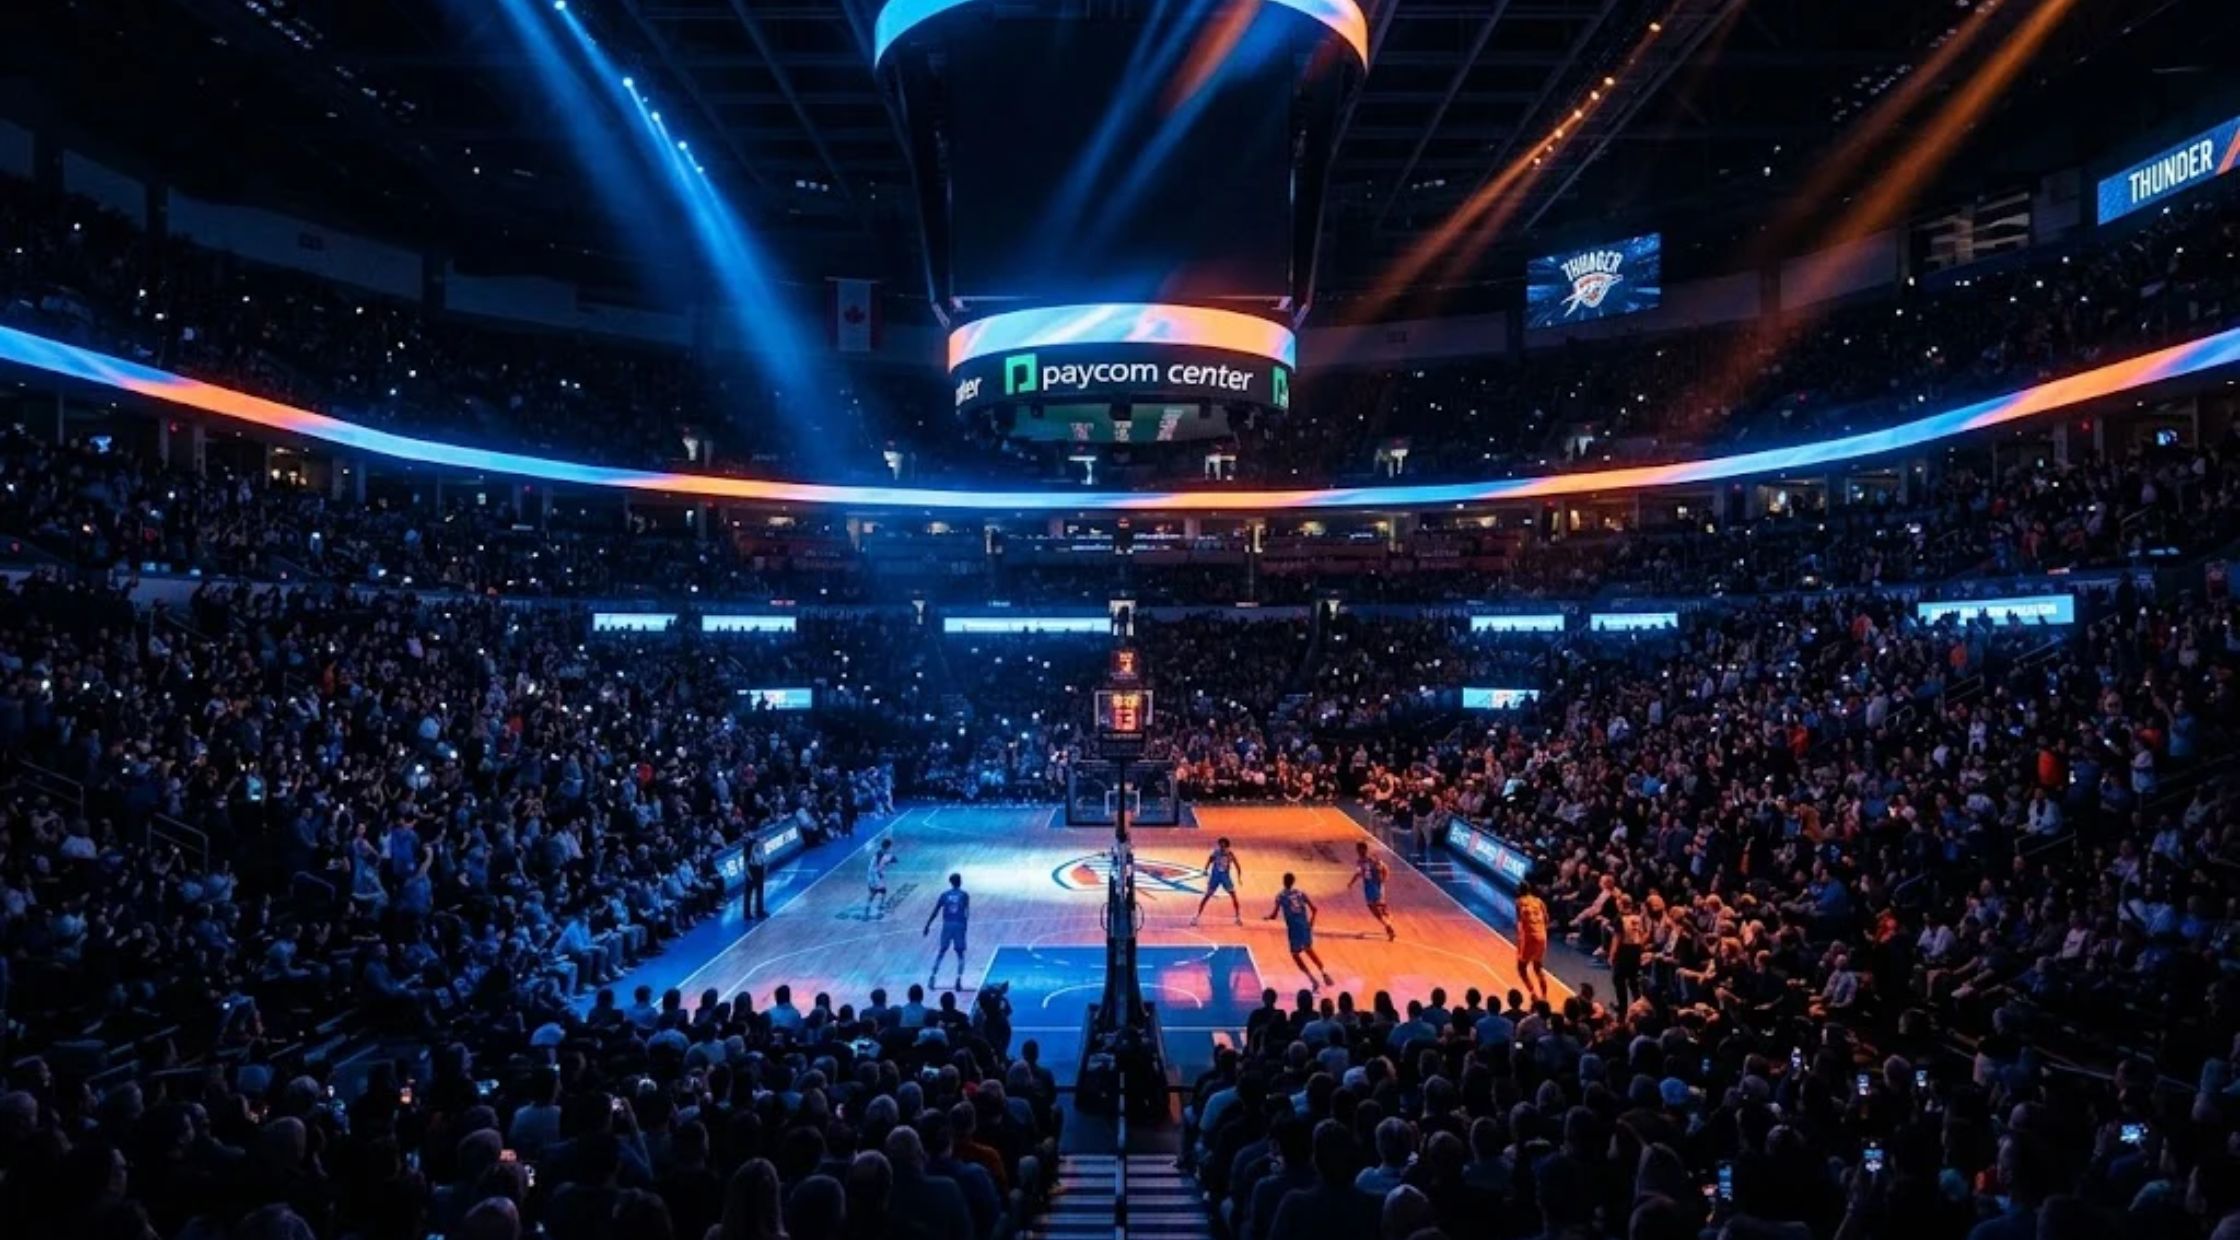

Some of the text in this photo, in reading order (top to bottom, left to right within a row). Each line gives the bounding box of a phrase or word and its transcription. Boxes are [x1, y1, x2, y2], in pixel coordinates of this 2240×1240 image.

[2127, 138, 2214, 204] THUNDER
[1042, 362, 1254, 391] paycom center
